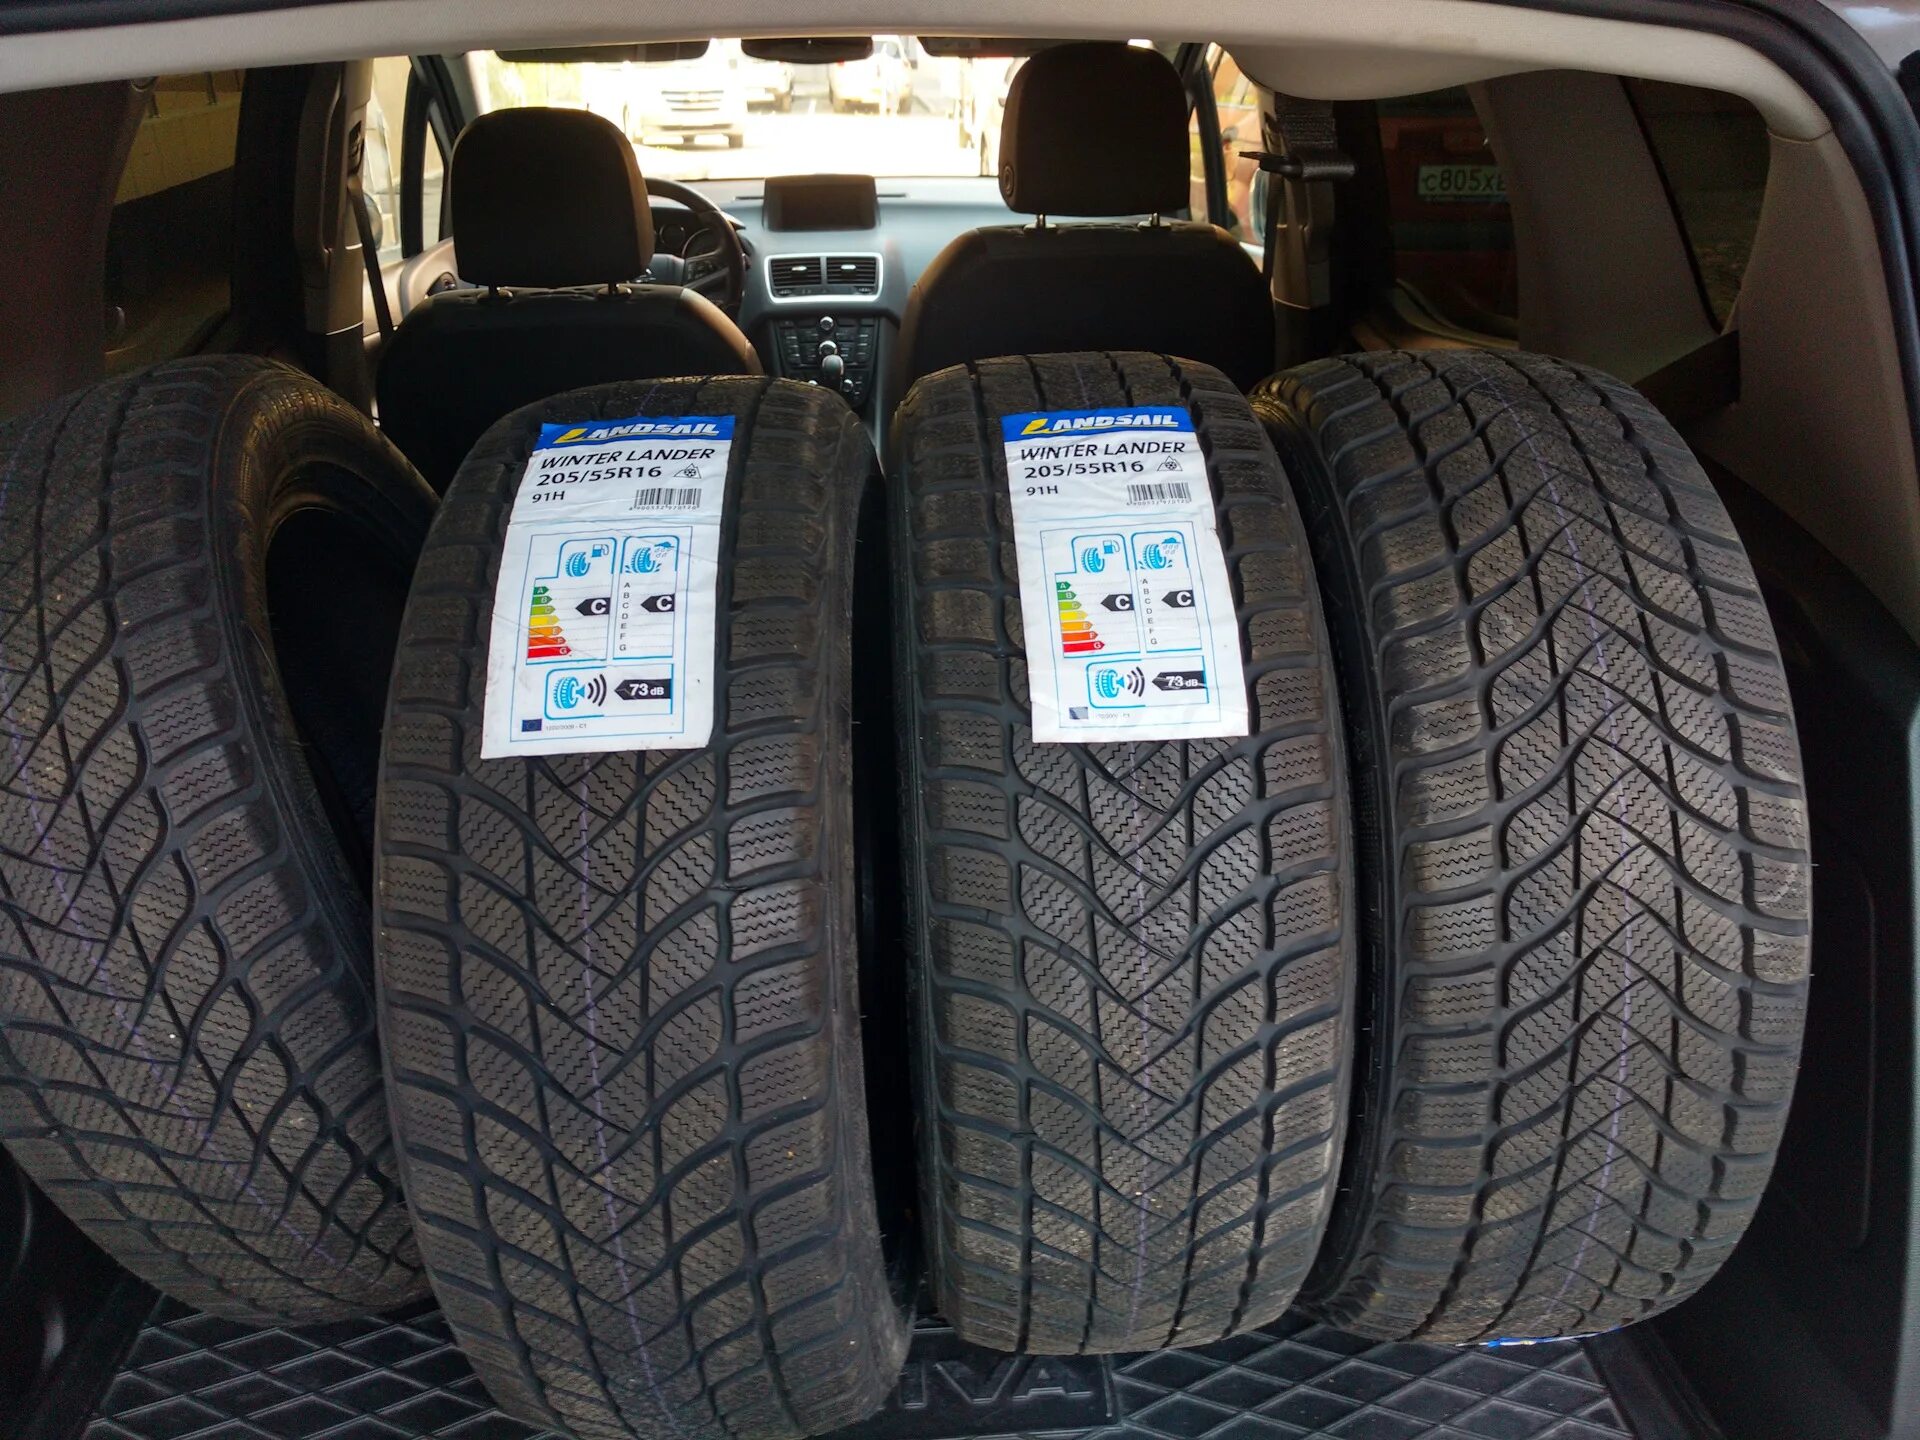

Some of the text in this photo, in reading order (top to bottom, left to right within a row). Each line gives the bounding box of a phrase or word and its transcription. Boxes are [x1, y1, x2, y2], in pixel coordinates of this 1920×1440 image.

[1021, 414, 1178, 435] LANDSAIL
[553, 423, 720, 444] LANDSAIL
[542, 448, 716, 469] WINTER LANDER
[1020, 442, 1185, 460] WINTER LANDER
[536, 466, 662, 486] 205/55R16
[1024, 460, 1144, 479] 205/55R16
[532, 491, 565, 504] 91H
[1026, 485, 1058, 496] 91H
[590, 598, 606, 614] C
[656, 595, 672, 611] C
[1115, 595, 1130, 610] C
[1176, 591, 1192, 606] C
[630, 683, 664, 696] 73 dB
[1166, 675, 1198, 688] 73 dB
